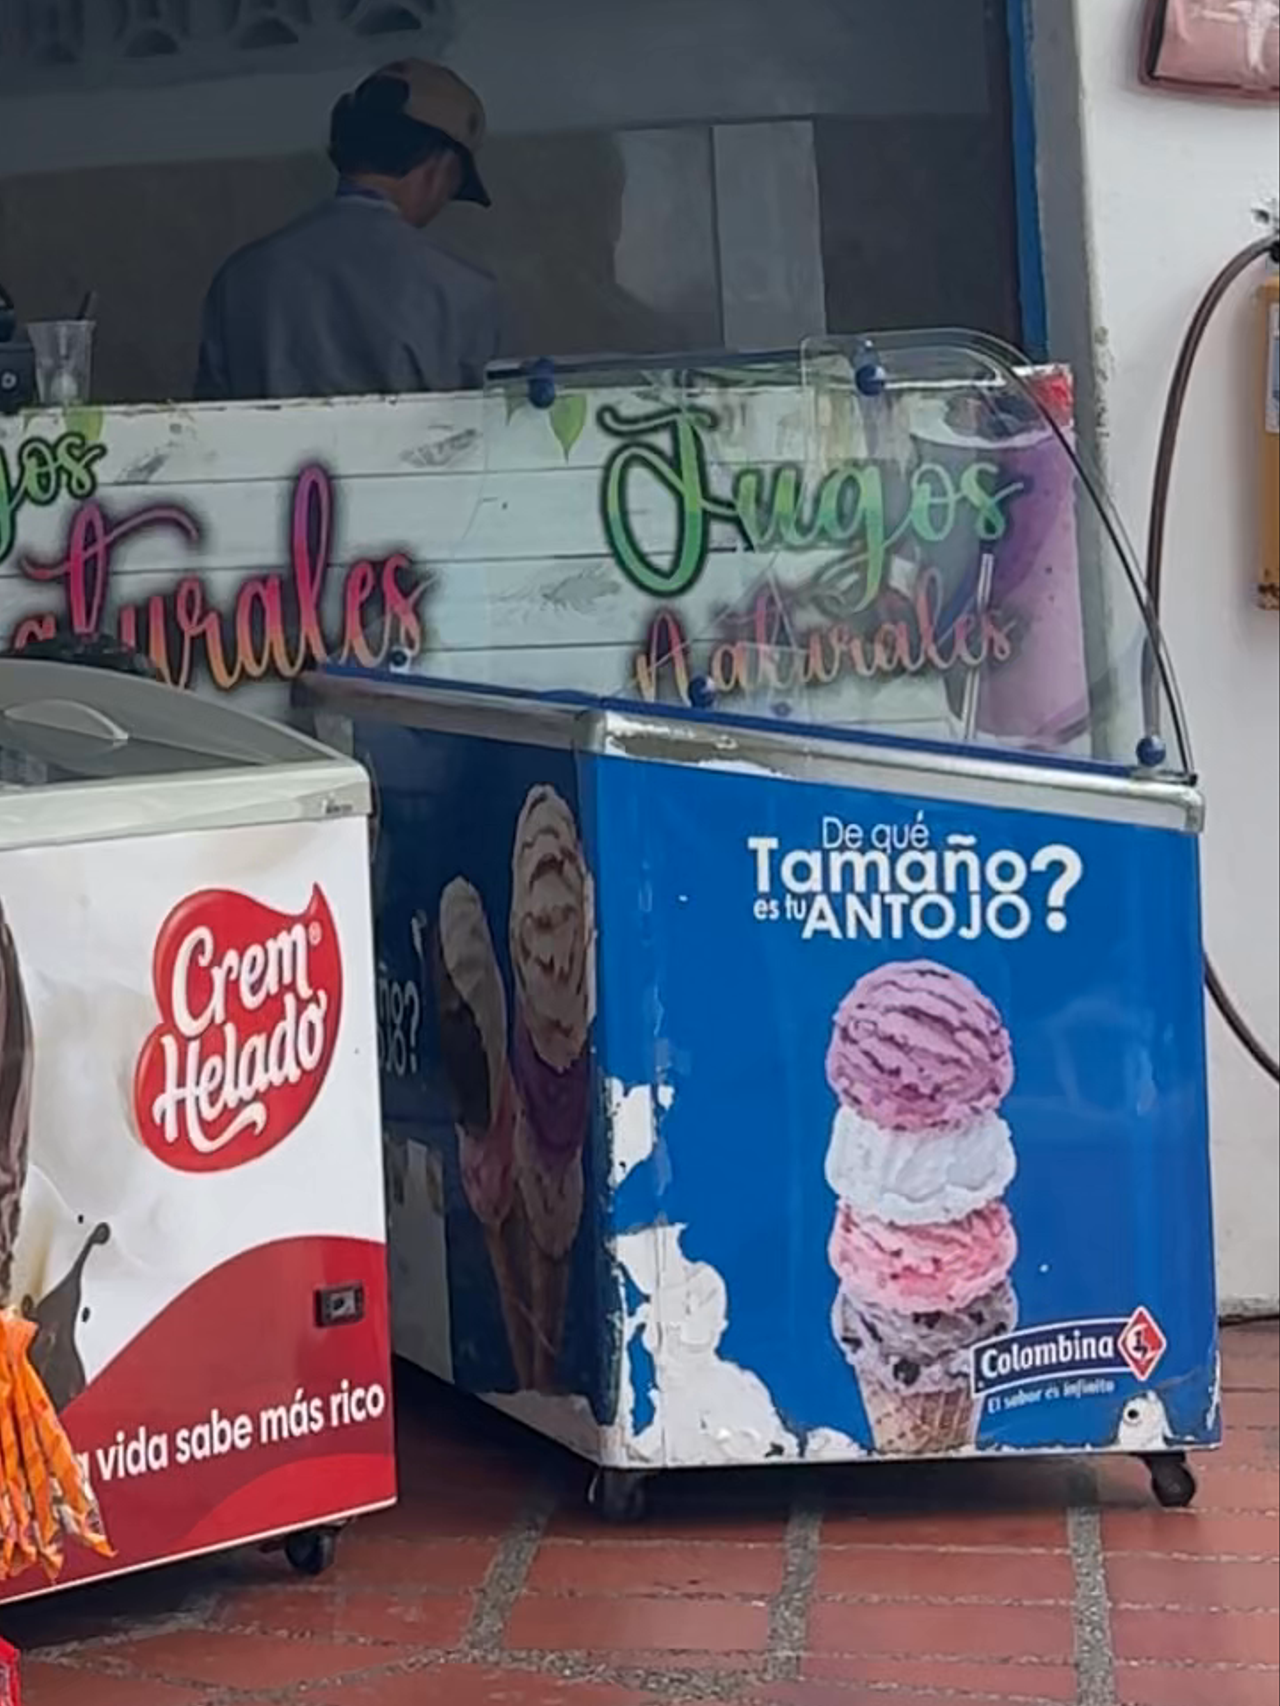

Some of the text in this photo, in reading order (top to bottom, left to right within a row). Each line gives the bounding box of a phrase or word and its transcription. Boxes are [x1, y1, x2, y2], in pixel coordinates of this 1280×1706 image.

[596, 403, 1025, 614] Jugos
[822, 810, 930, 854] De qué
[753, 895, 780, 921] es
[785, 893, 807, 920] tu
[171, 923, 314, 1038] Crem
[151, 988, 328, 1154] Helado
[980, 1328, 1115, 1379] Colombina
[95, 1425, 169, 1481] vida
[175, 1408, 253, 1464] sabe
[259, 1387, 325, 1443] más
[330, 1378, 386, 1427] rico
